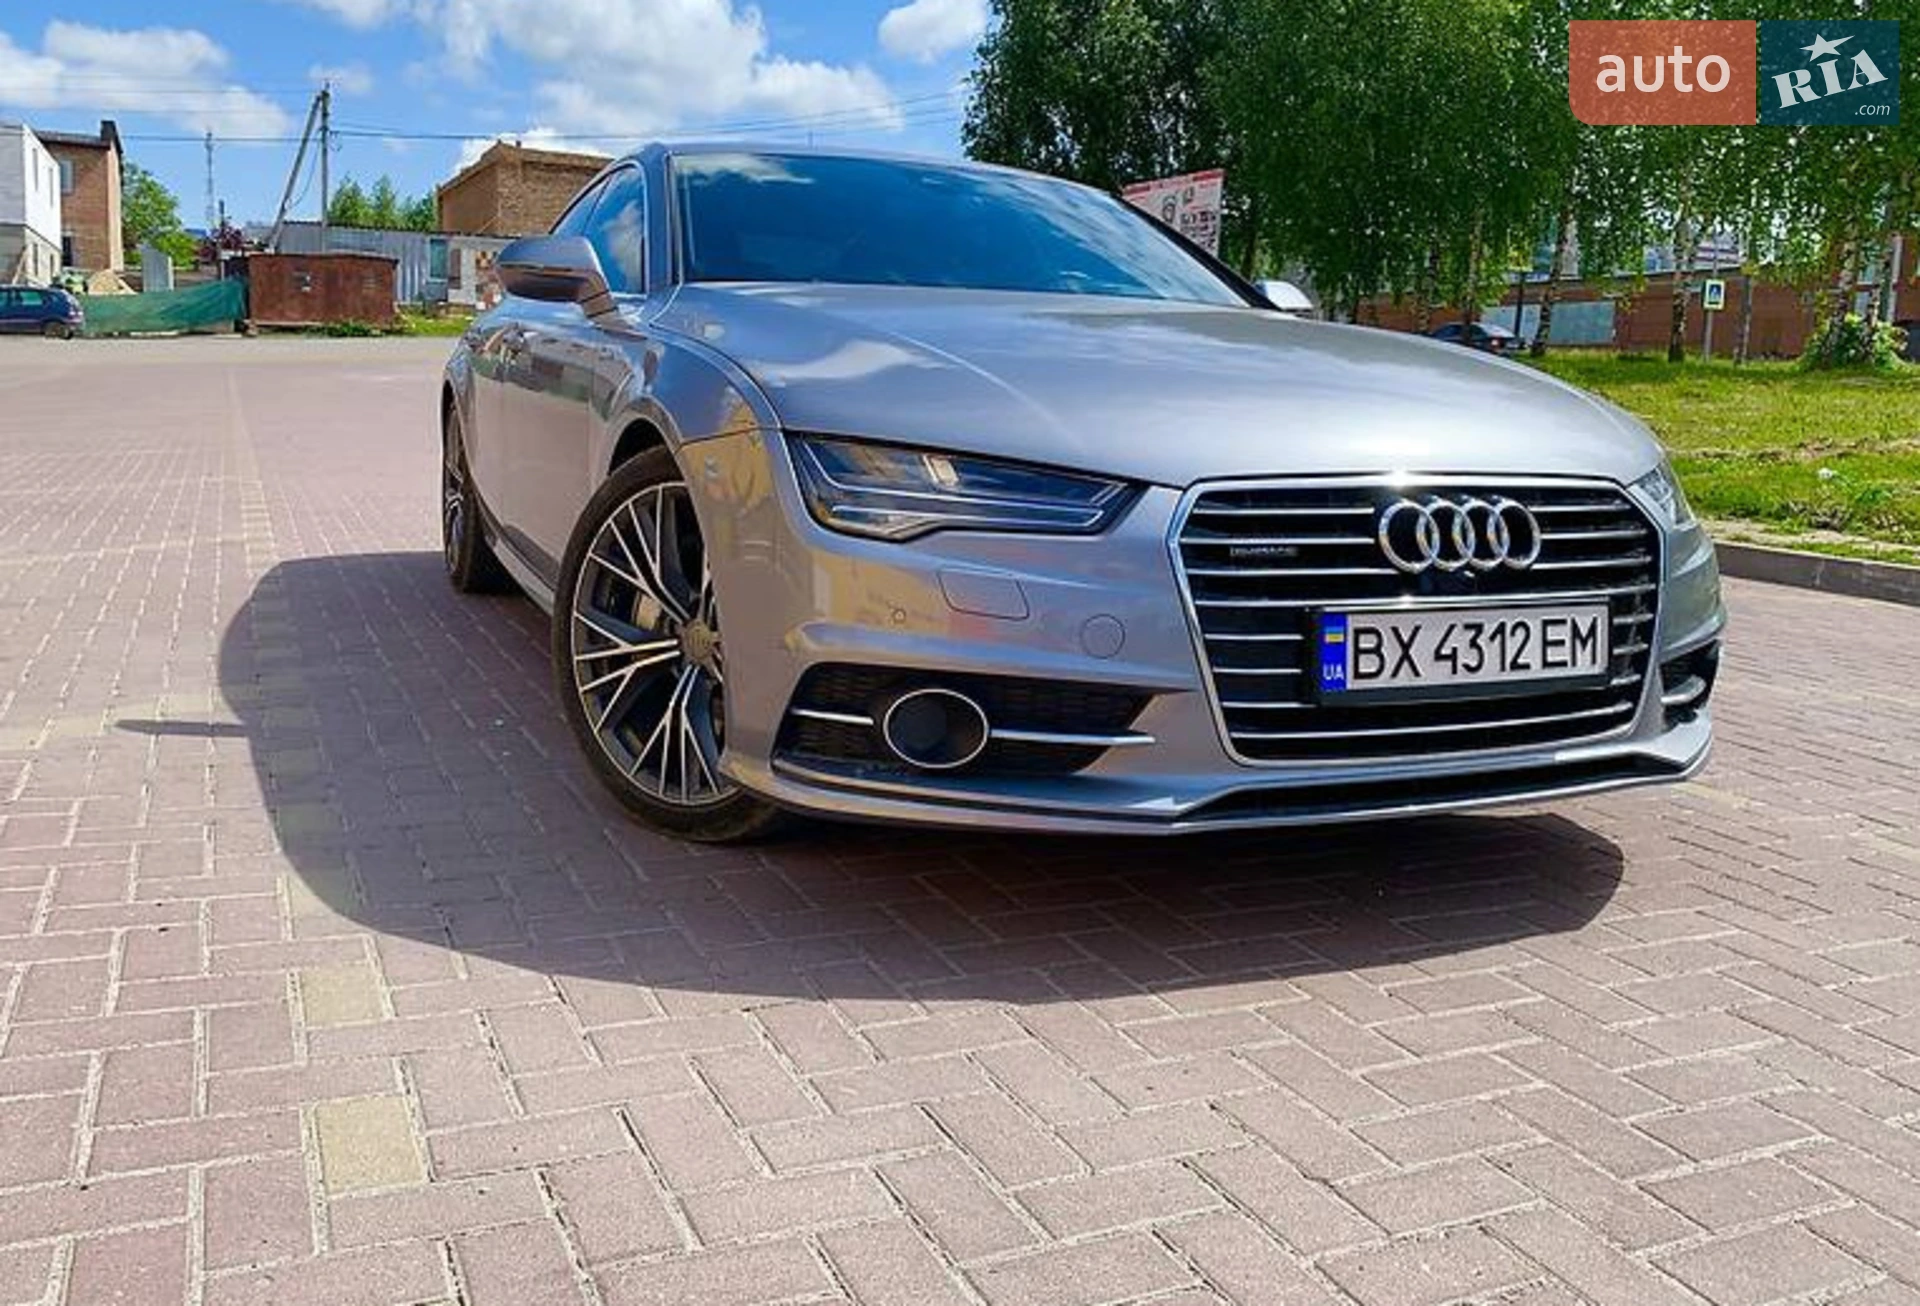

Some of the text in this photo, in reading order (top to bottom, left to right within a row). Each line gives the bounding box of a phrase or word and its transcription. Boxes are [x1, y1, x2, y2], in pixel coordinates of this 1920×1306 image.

[1352, 616, 1597, 681] BX 4312 EM
[1322, 664, 1344, 681] UA
